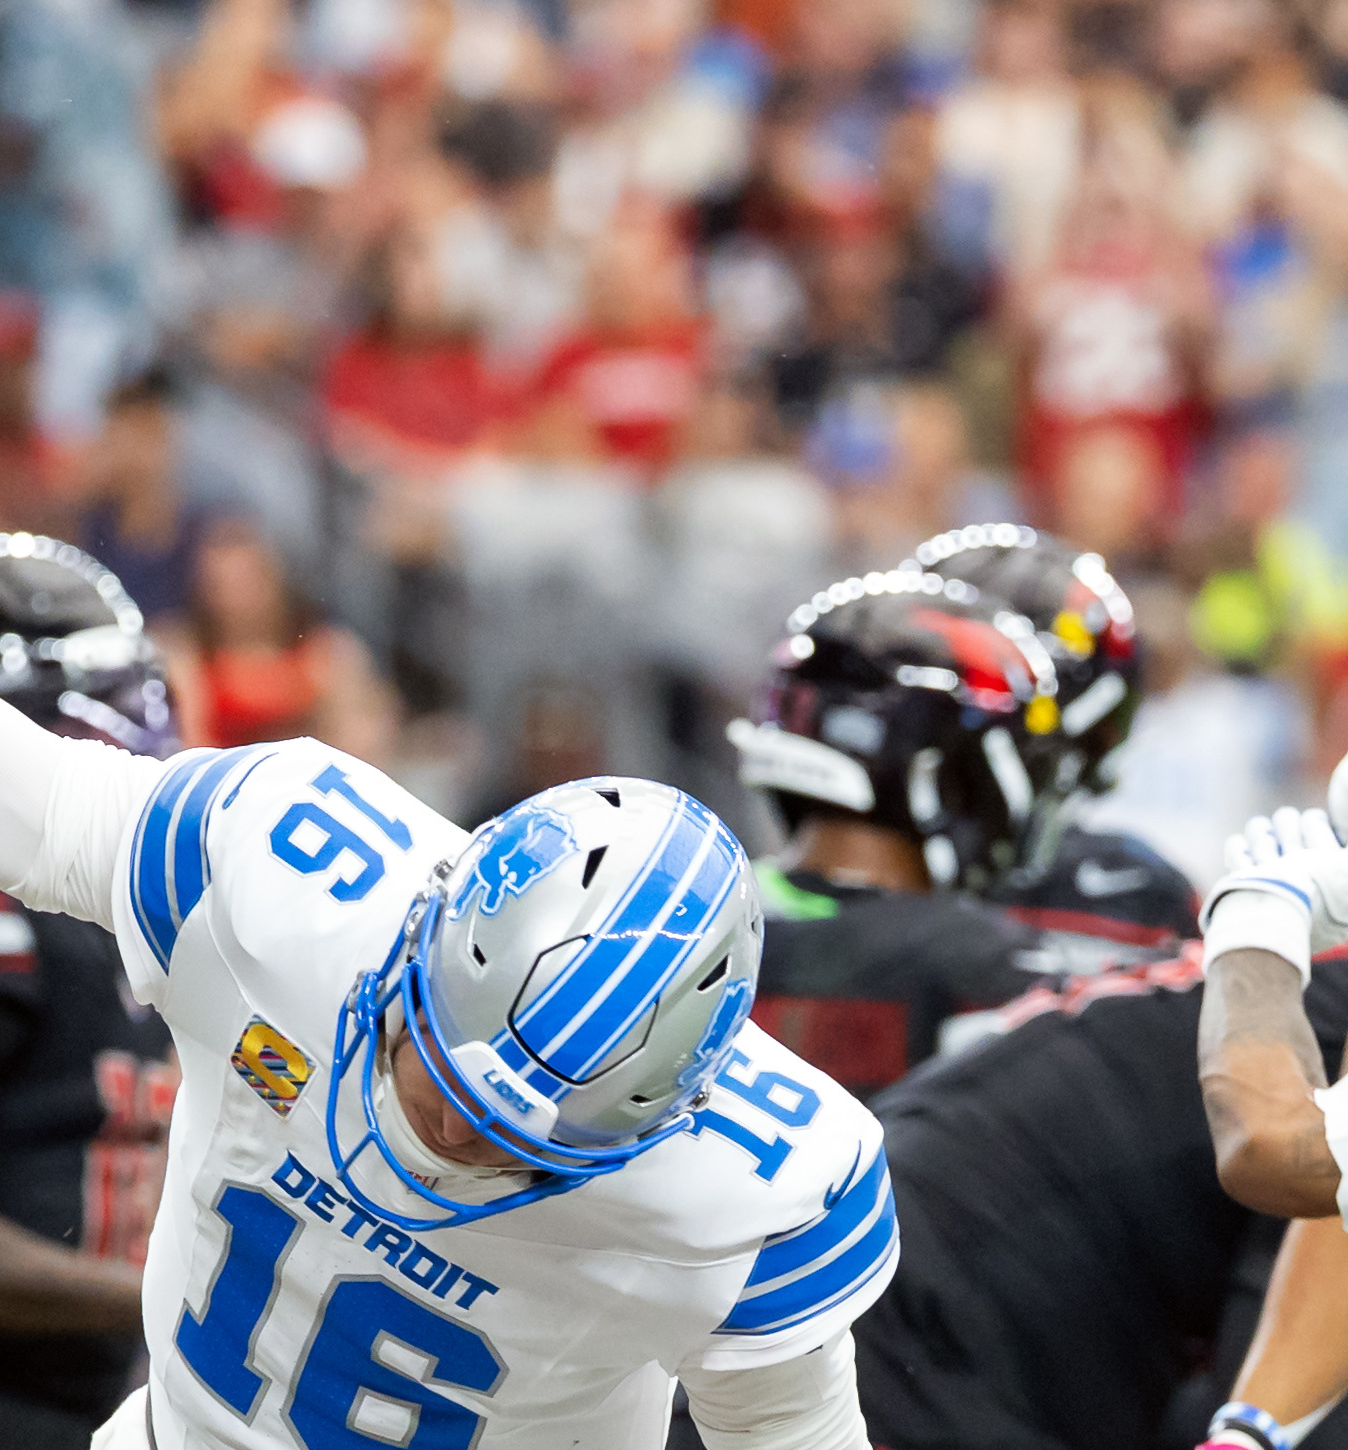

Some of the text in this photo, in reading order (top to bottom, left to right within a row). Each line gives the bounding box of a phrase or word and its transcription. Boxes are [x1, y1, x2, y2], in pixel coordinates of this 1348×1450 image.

[264, 760, 415, 906] 16
[482, 1069, 537, 1117] LIONS
[683, 1046, 825, 1188] 16
[270, 1150, 501, 1312] DETROIT
